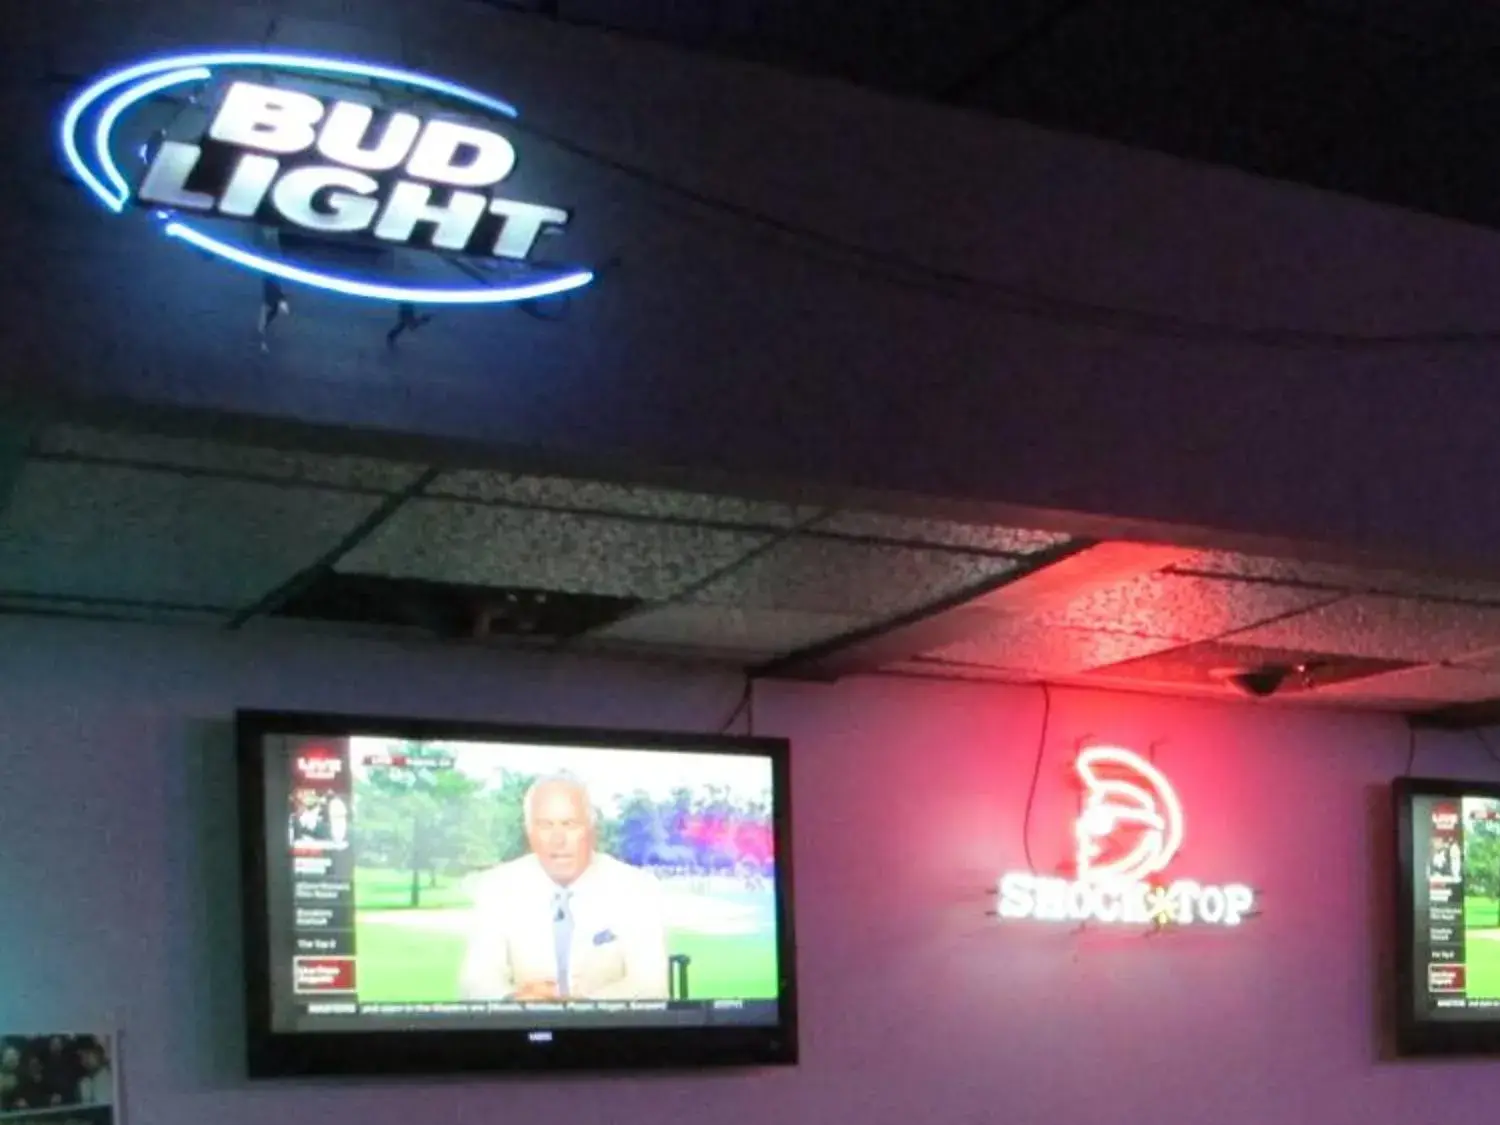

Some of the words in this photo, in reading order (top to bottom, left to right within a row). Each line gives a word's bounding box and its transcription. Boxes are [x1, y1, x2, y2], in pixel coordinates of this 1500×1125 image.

[208, 80, 516, 187] BUD
[138, 140, 571, 260] LIGHT
[998, 872, 1152, 923] SHOCK
[1167, 880, 1254, 925] TOP
